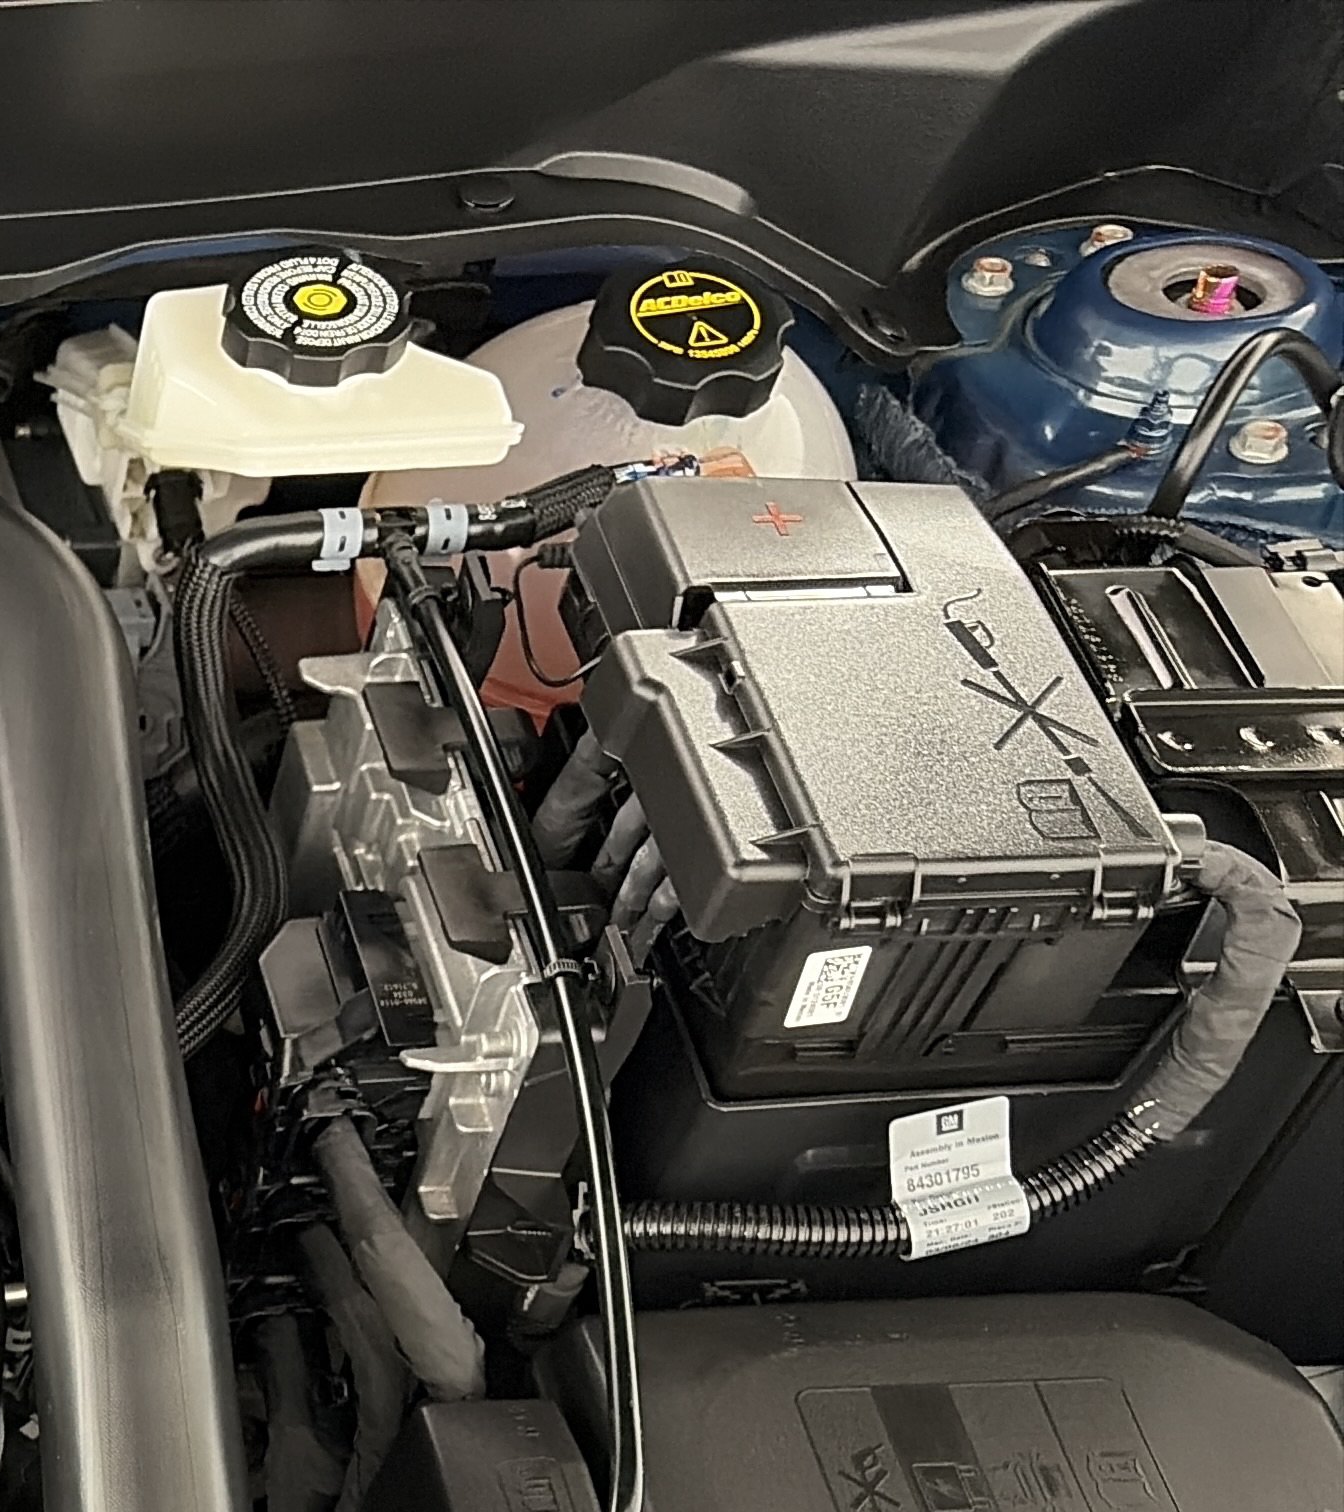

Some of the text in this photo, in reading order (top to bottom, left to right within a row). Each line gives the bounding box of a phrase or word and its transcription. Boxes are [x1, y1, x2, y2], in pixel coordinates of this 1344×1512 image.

[638, 291, 741, 312] ACDelco
[910, 1142, 952, 1159] Assembly
[955, 1139, 964, 1148] in
[907, 1164, 981, 1192] 84301795
[993, 1209, 1015, 1221] 202
